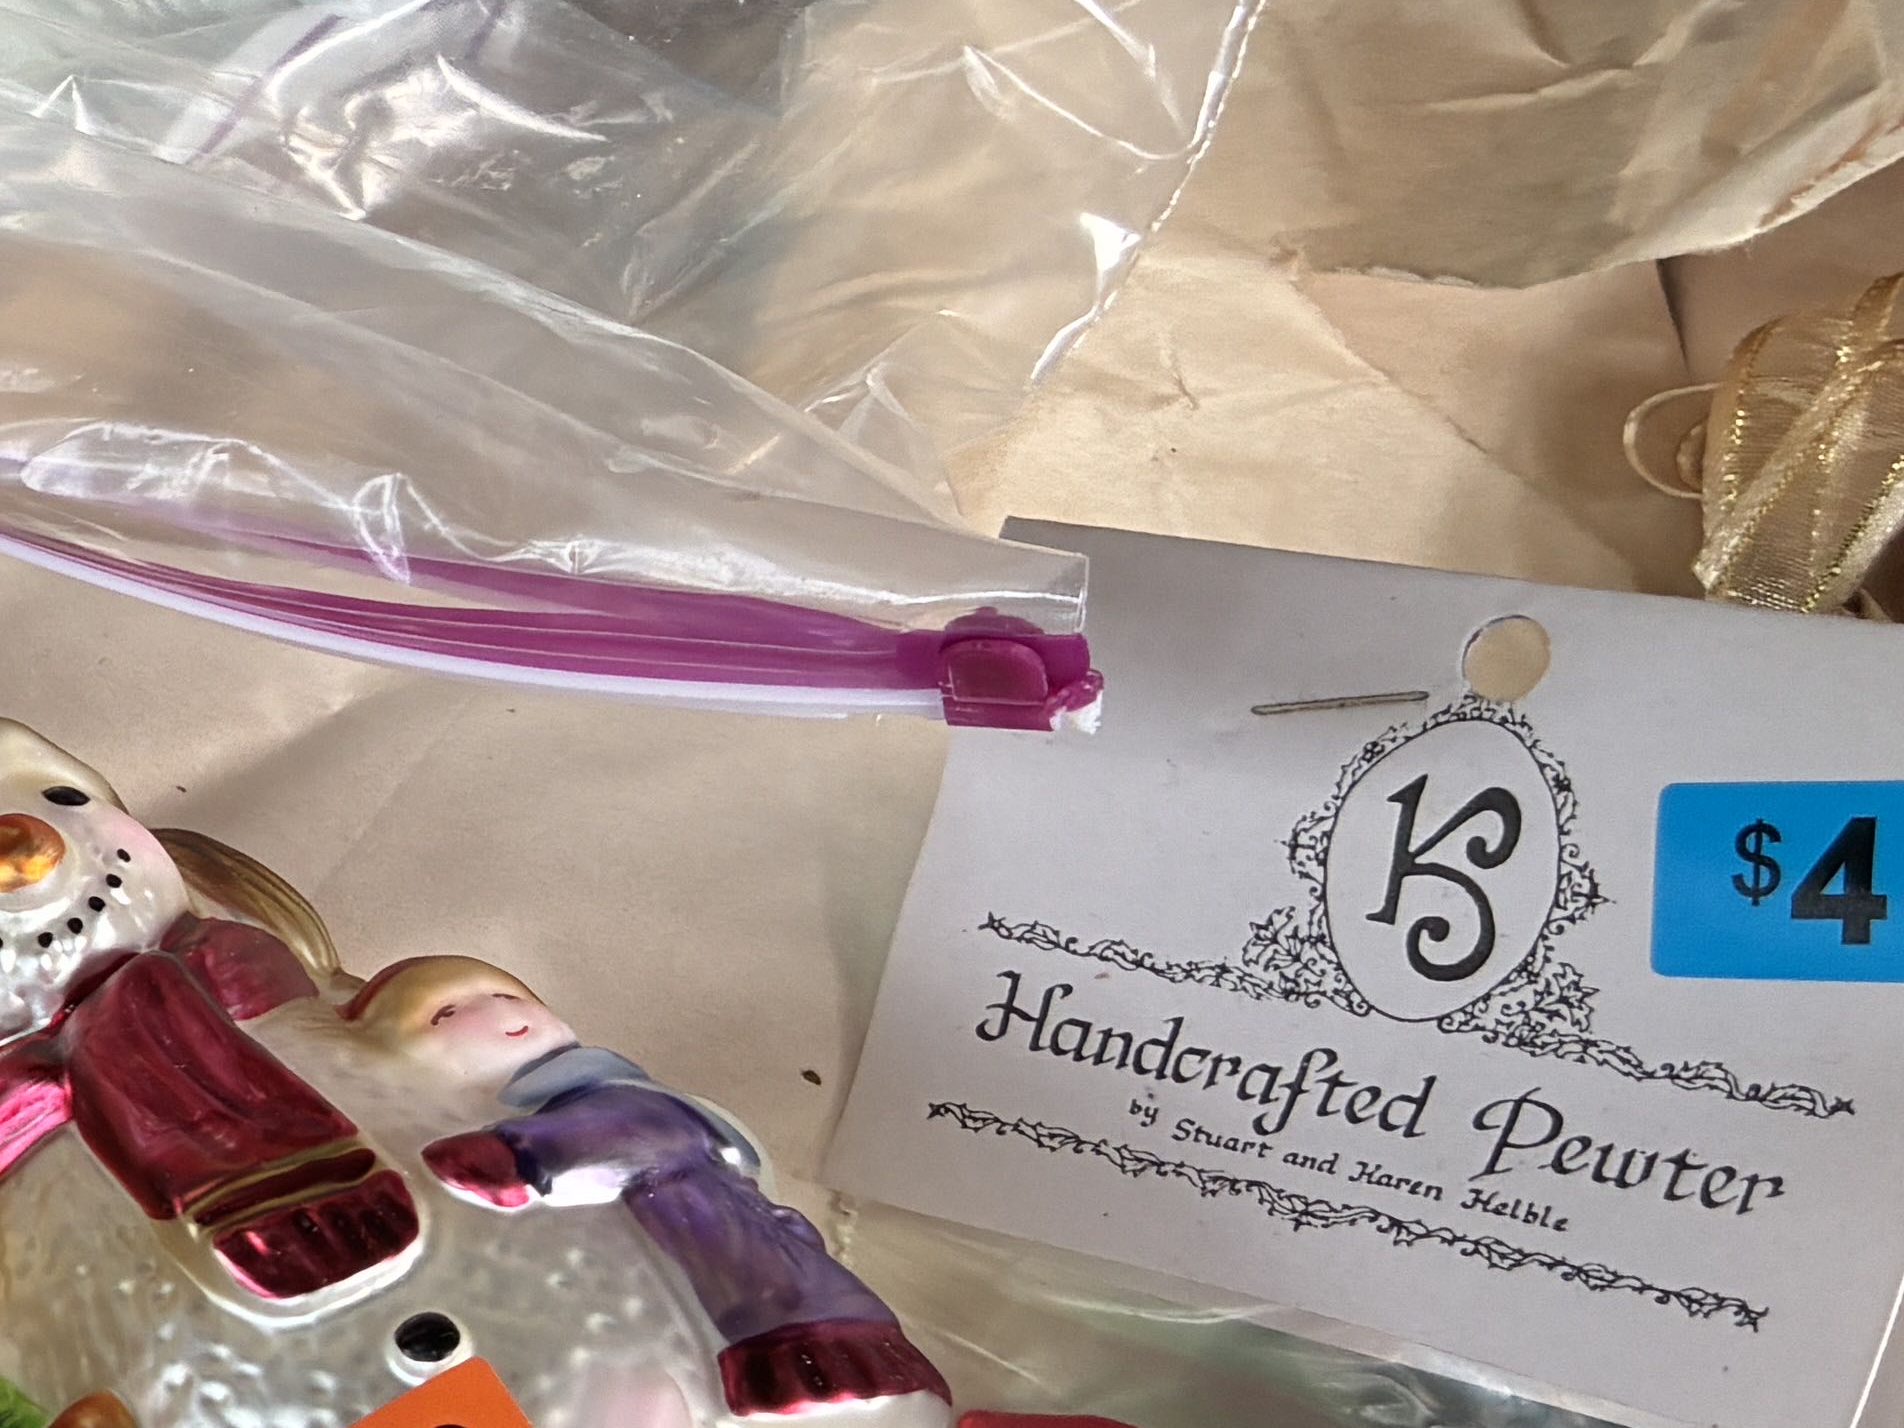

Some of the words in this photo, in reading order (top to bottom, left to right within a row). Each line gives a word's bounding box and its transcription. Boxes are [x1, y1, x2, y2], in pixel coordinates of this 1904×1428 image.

[1730, 815, 1890, 947] $4
[975, 969, 1438, 1138] Handcrafted
[1468, 1086, 1787, 1217] Pewter
[1128, 1098, 1160, 1128] by
[1170, 1117, 1274, 1160] Stuart
[1282, 1151, 1340, 1176] and
[1347, 1160, 1444, 1202] Karen
